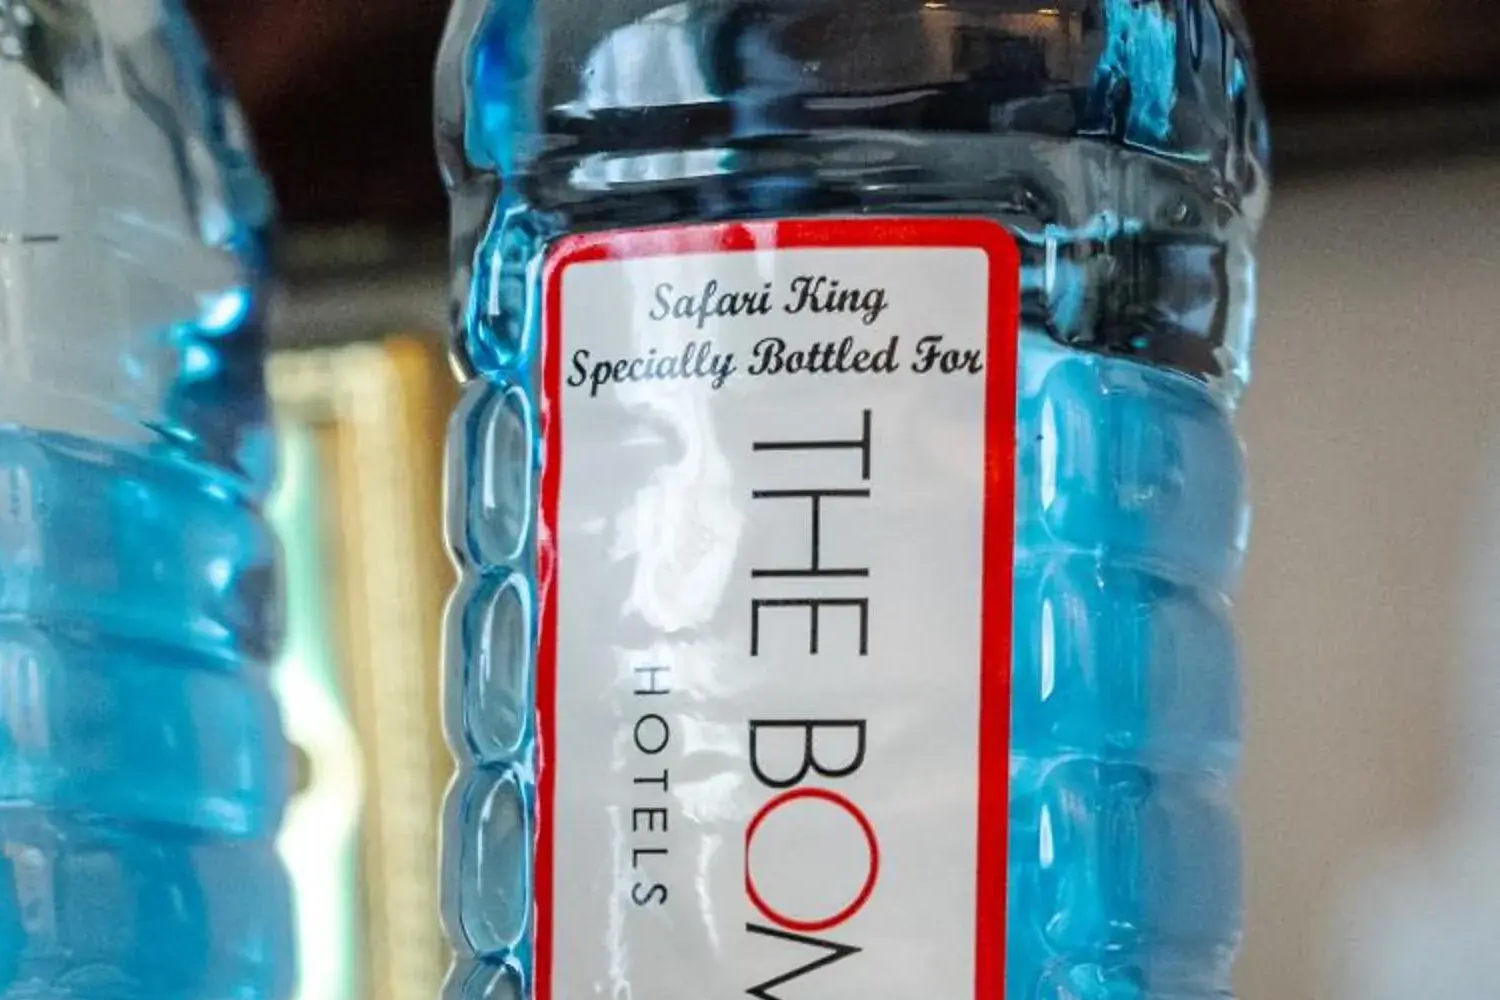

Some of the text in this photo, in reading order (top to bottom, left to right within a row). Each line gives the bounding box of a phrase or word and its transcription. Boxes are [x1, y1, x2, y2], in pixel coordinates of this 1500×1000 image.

[567, 335, 983, 396] Specially Bottled For
[650, 275, 888, 328] Safari King
[752, 409, 871, 657] THE
[631, 664, 670, 907] HOTELS
